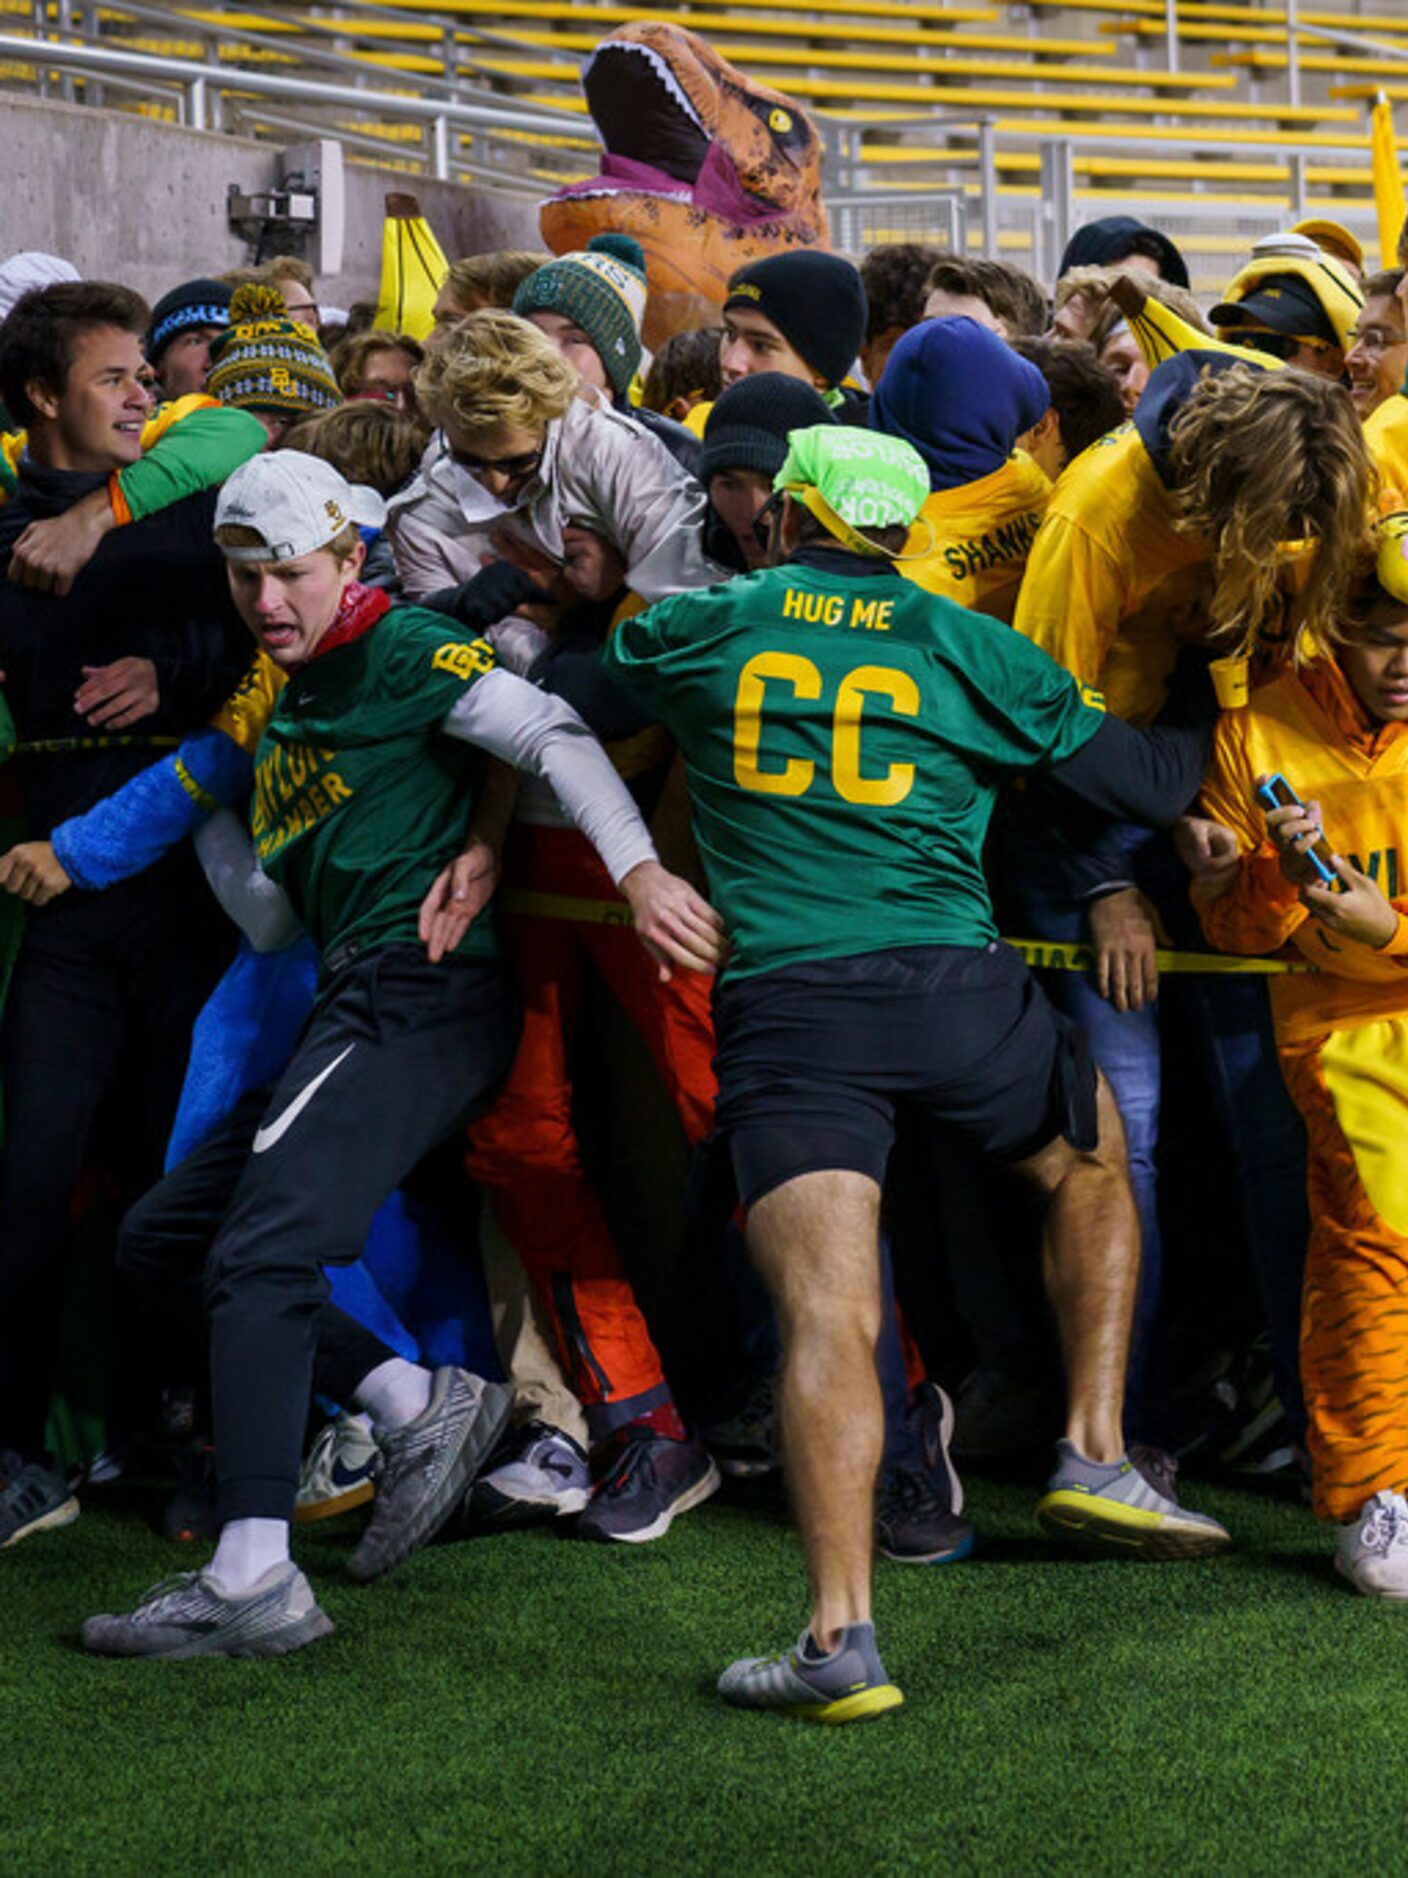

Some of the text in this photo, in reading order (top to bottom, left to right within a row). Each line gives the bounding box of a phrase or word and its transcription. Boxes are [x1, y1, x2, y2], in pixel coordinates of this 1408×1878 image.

[782, 588, 895, 630] HUG ME
[734, 651, 920, 807] CC
